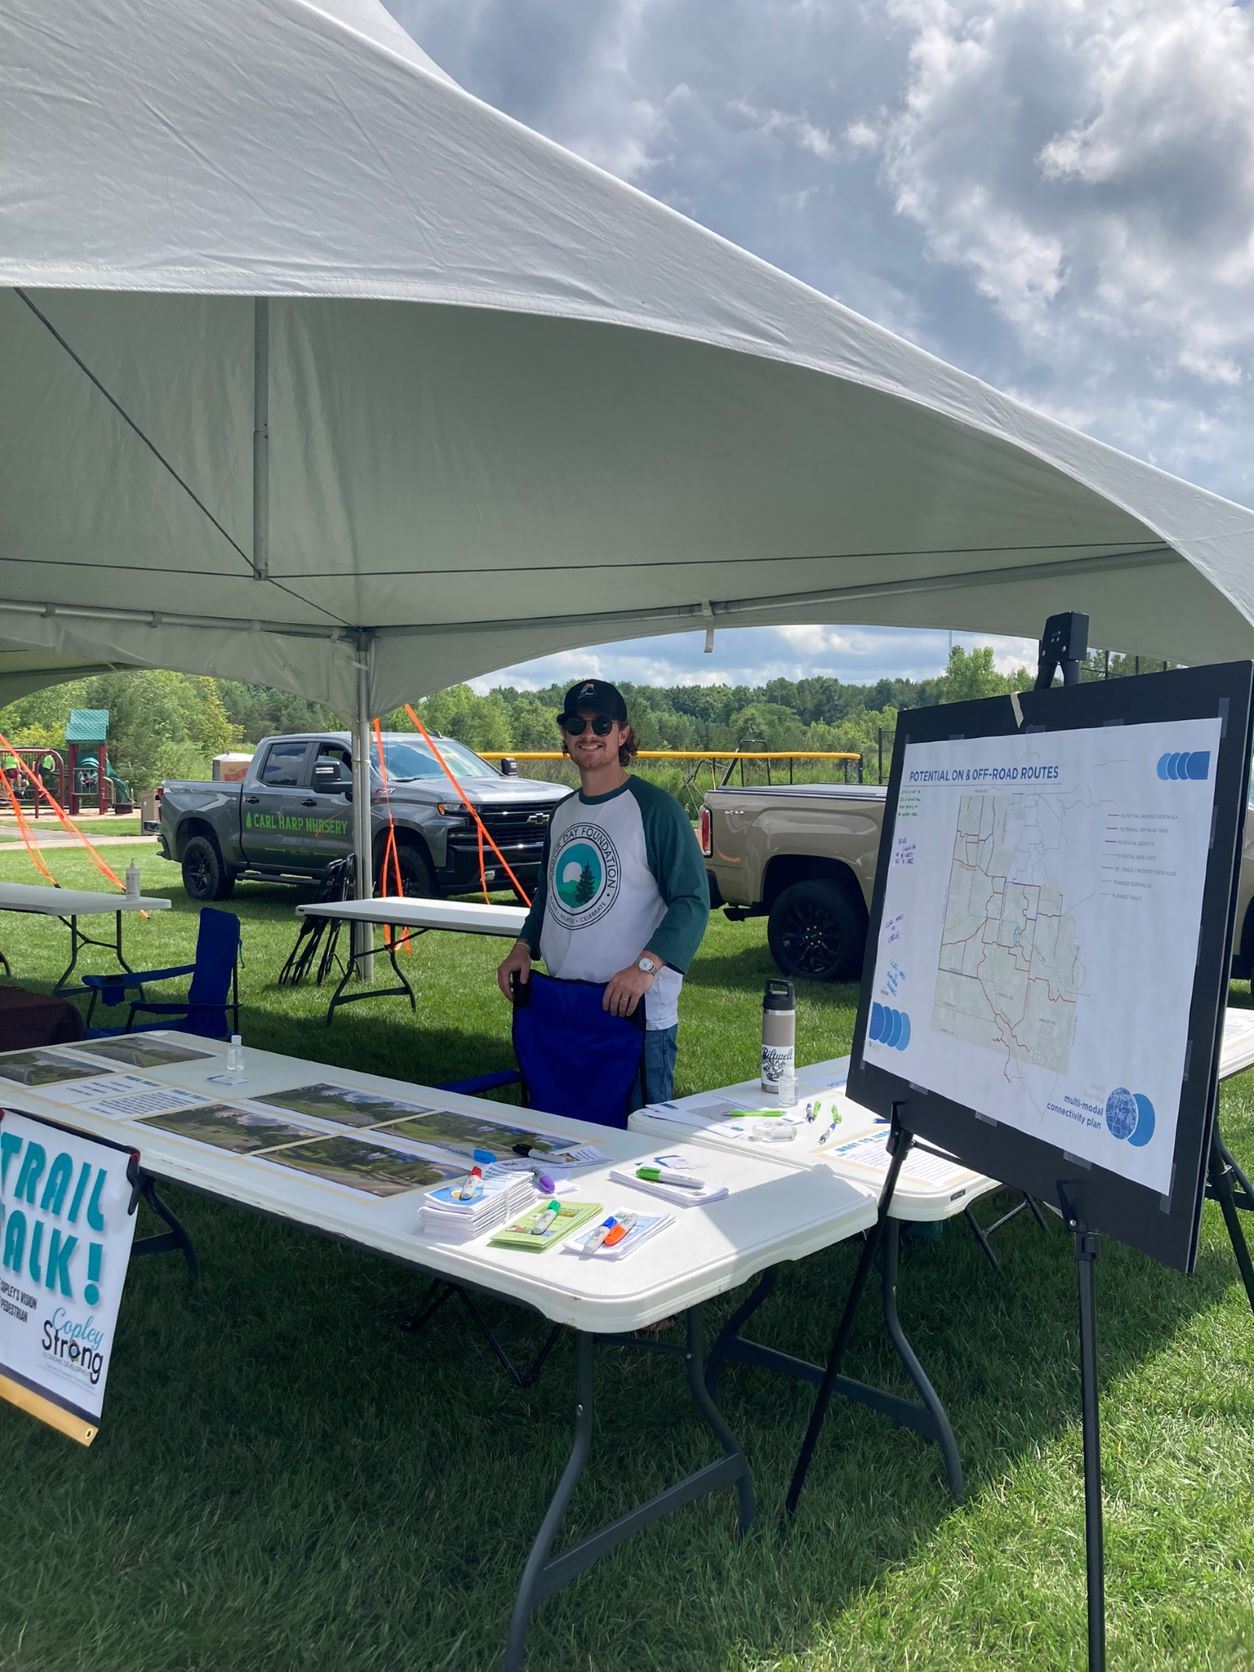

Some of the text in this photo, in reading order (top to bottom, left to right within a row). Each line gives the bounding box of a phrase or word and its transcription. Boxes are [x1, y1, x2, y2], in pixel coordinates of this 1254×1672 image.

[909, 765, 1059, 782] POTENTIAL ON & OFF-ROAD ROUTES
[253, 813, 348, 835] CARL HARP NURSERY
[563, 827, 579, 842] DAY
[581, 827, 617, 889] FOUNDATION
[579, 902, 607, 923] CELEBRATE
[1046, 1102, 1102, 1130] connectivity plan
[1063, 1095, 1104, 1117] multi-modal
[0, 1131, 108, 1232] TRAIL
[0, 1202, 103, 1306] ALK!
[20, 1291, 38, 1310] VISION
[52, 1307, 104, 1350] Copley
[42, 1319, 104, 1385] Strong
